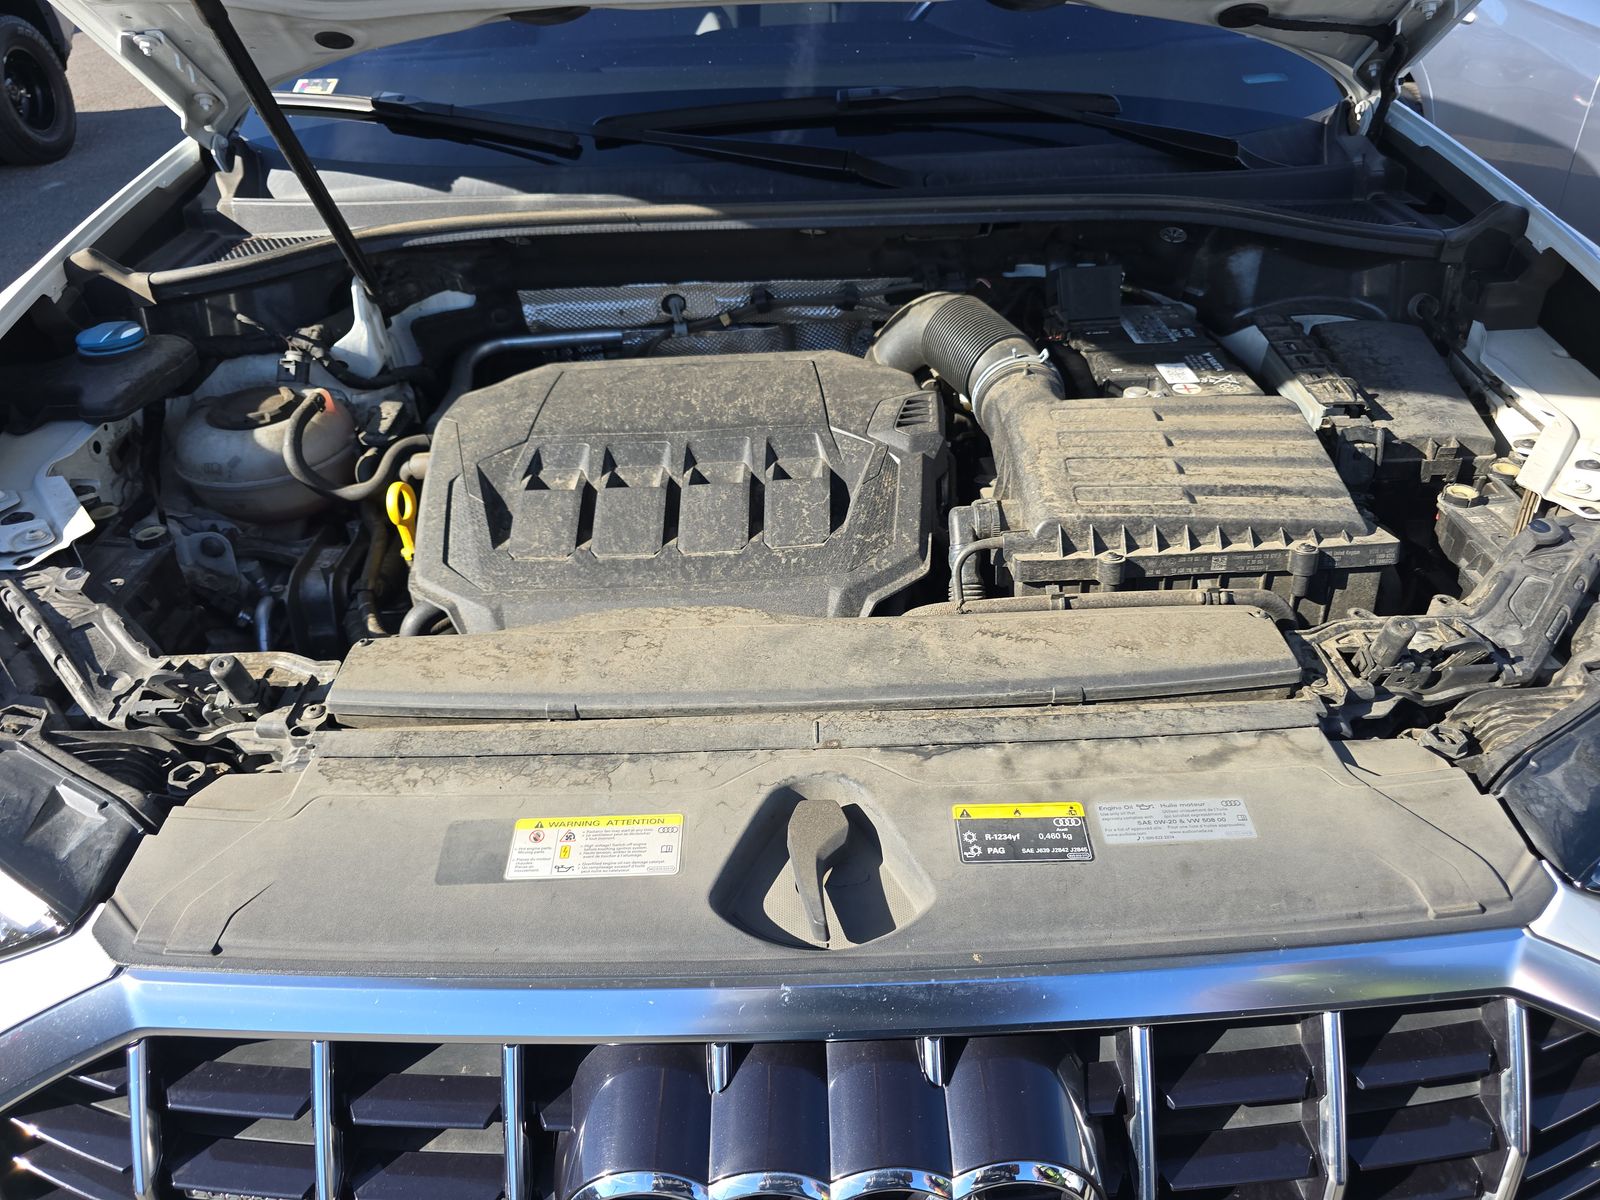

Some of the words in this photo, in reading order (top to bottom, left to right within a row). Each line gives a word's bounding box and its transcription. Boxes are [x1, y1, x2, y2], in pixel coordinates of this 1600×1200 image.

[548, 820, 600, 828] WARNING
[606, 818, 665, 826] ATTENTION
[984, 832, 1021, 842] R-1234yf
[1062, 832, 1073, 840] kg
